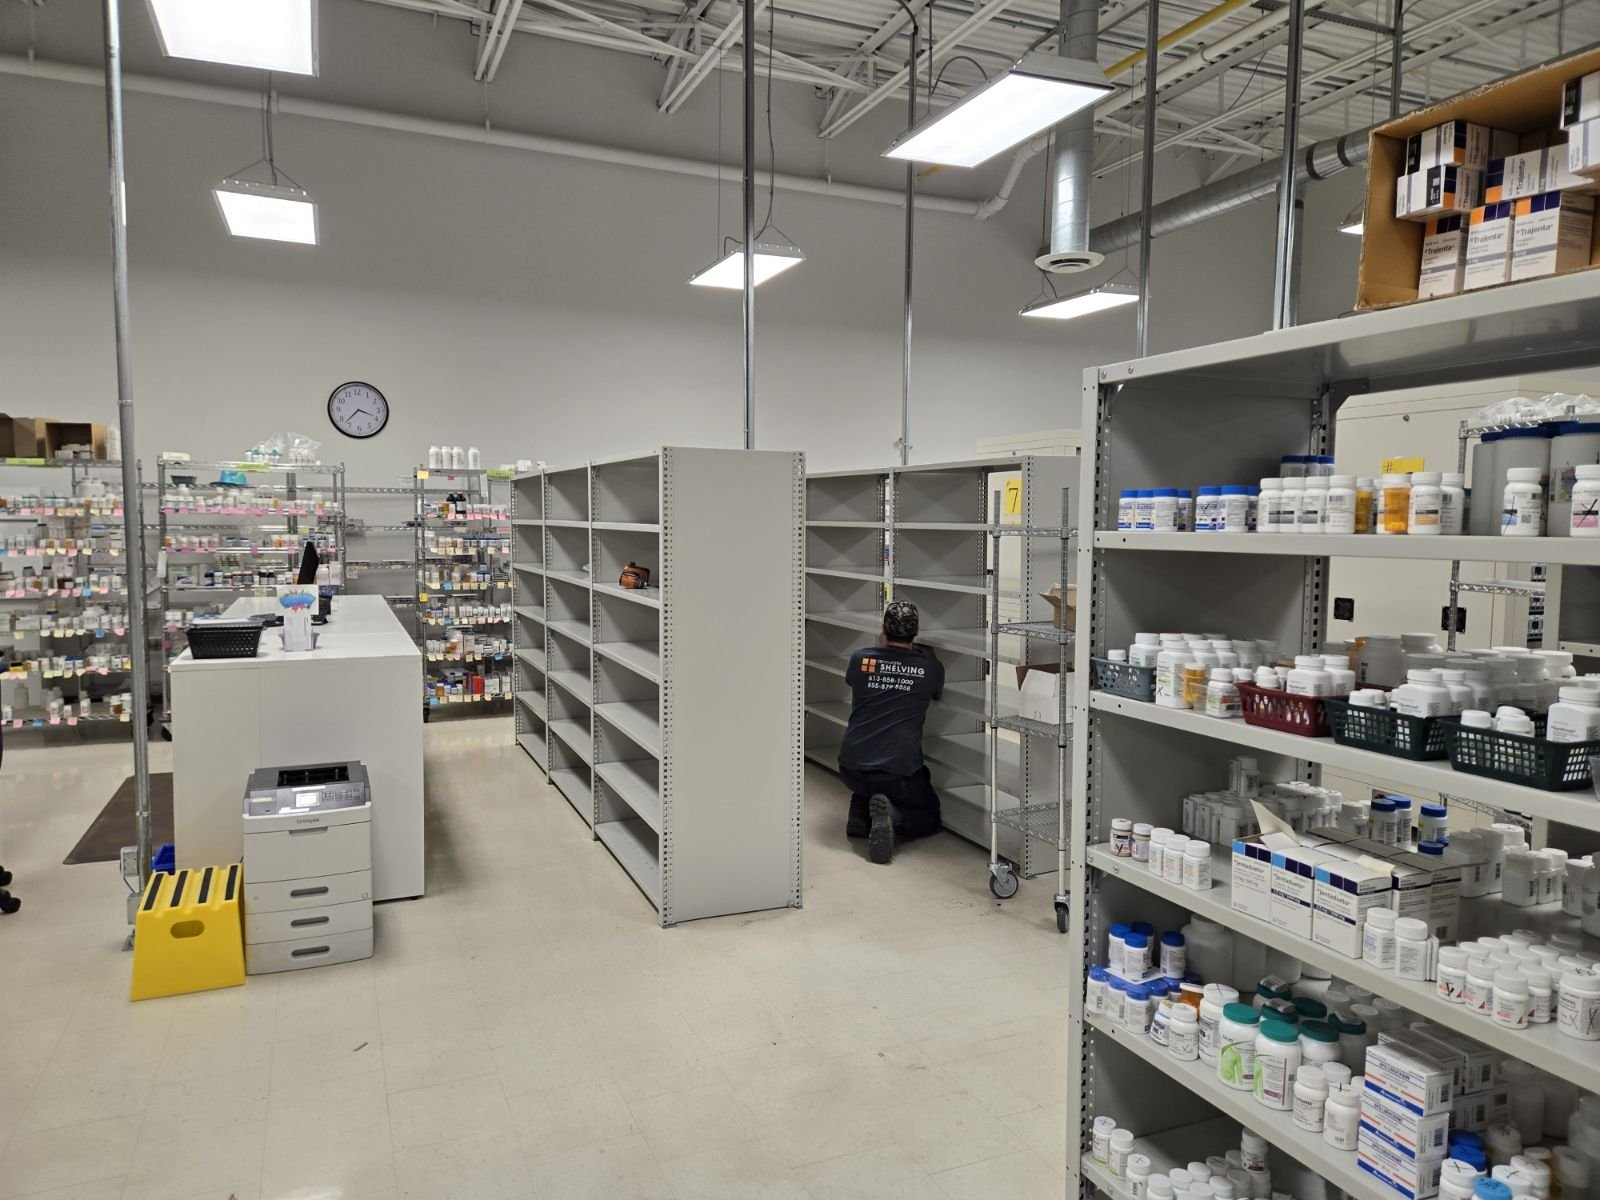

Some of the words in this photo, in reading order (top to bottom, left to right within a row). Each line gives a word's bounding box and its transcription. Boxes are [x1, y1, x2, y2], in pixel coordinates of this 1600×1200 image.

[1521, 223, 1553, 236] Trajenta
[1473, 232, 1504, 244] Trajenta
[354, 388, 362, 396] 12
[1008, 487, 1019, 513] 7
[880, 663, 925, 675] SHELVING
